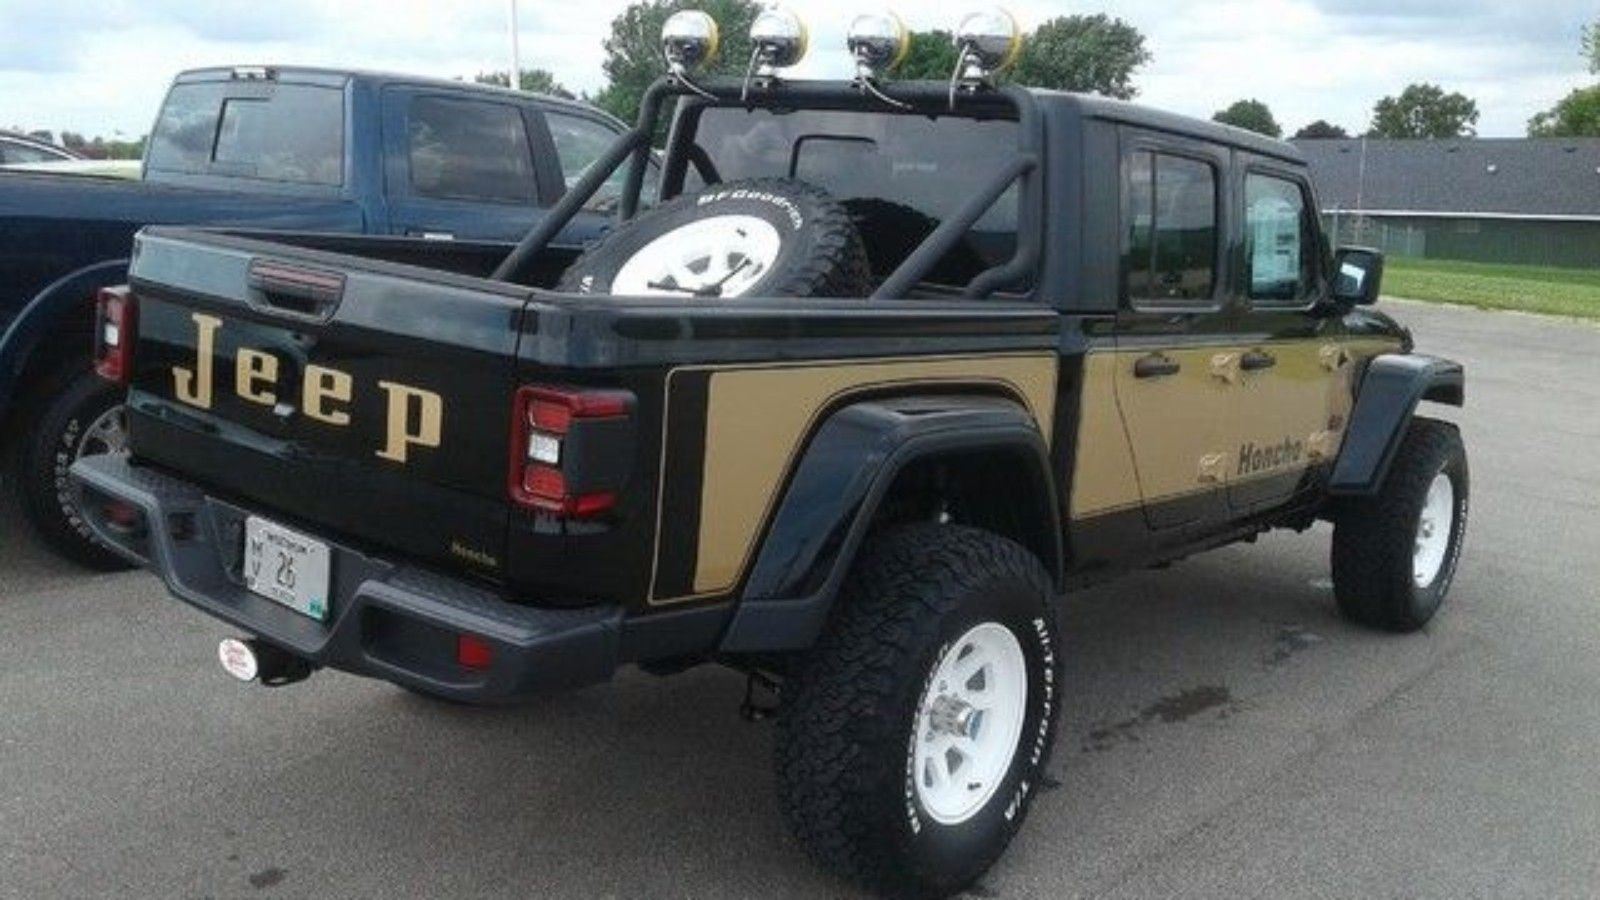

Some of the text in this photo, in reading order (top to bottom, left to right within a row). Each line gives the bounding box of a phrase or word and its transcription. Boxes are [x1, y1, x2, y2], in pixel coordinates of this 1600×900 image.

[172, 312, 443, 463] Jeep
[1237, 434, 1302, 475] Honcho
[277, 551, 296, 590] 26
